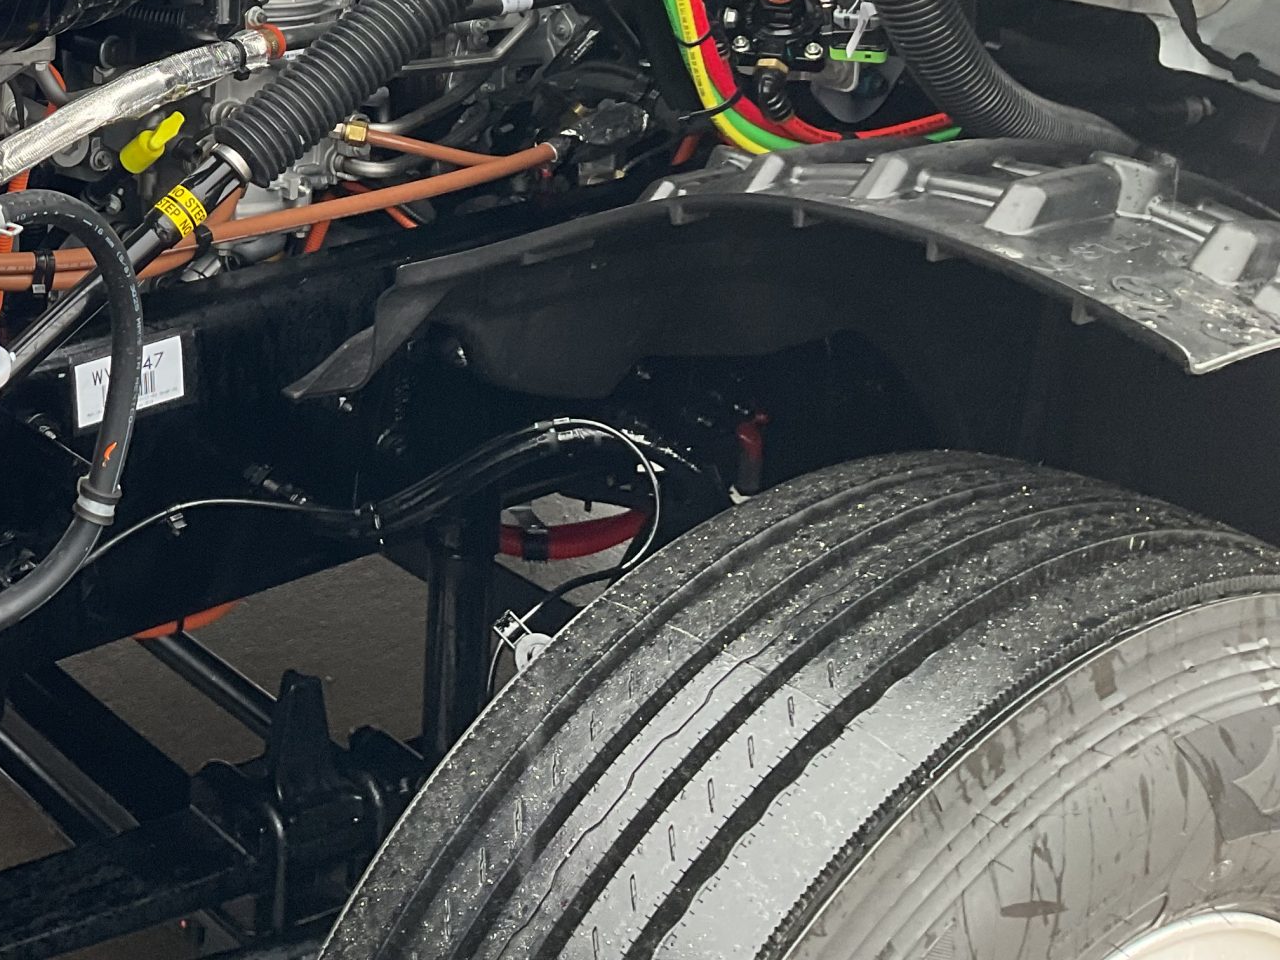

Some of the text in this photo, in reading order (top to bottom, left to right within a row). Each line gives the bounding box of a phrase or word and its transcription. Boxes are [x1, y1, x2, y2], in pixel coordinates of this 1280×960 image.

[155, 199, 192, 236] STEP NO
[185, 197, 205, 222] STEP
[91, 351, 165, 386] WV47
